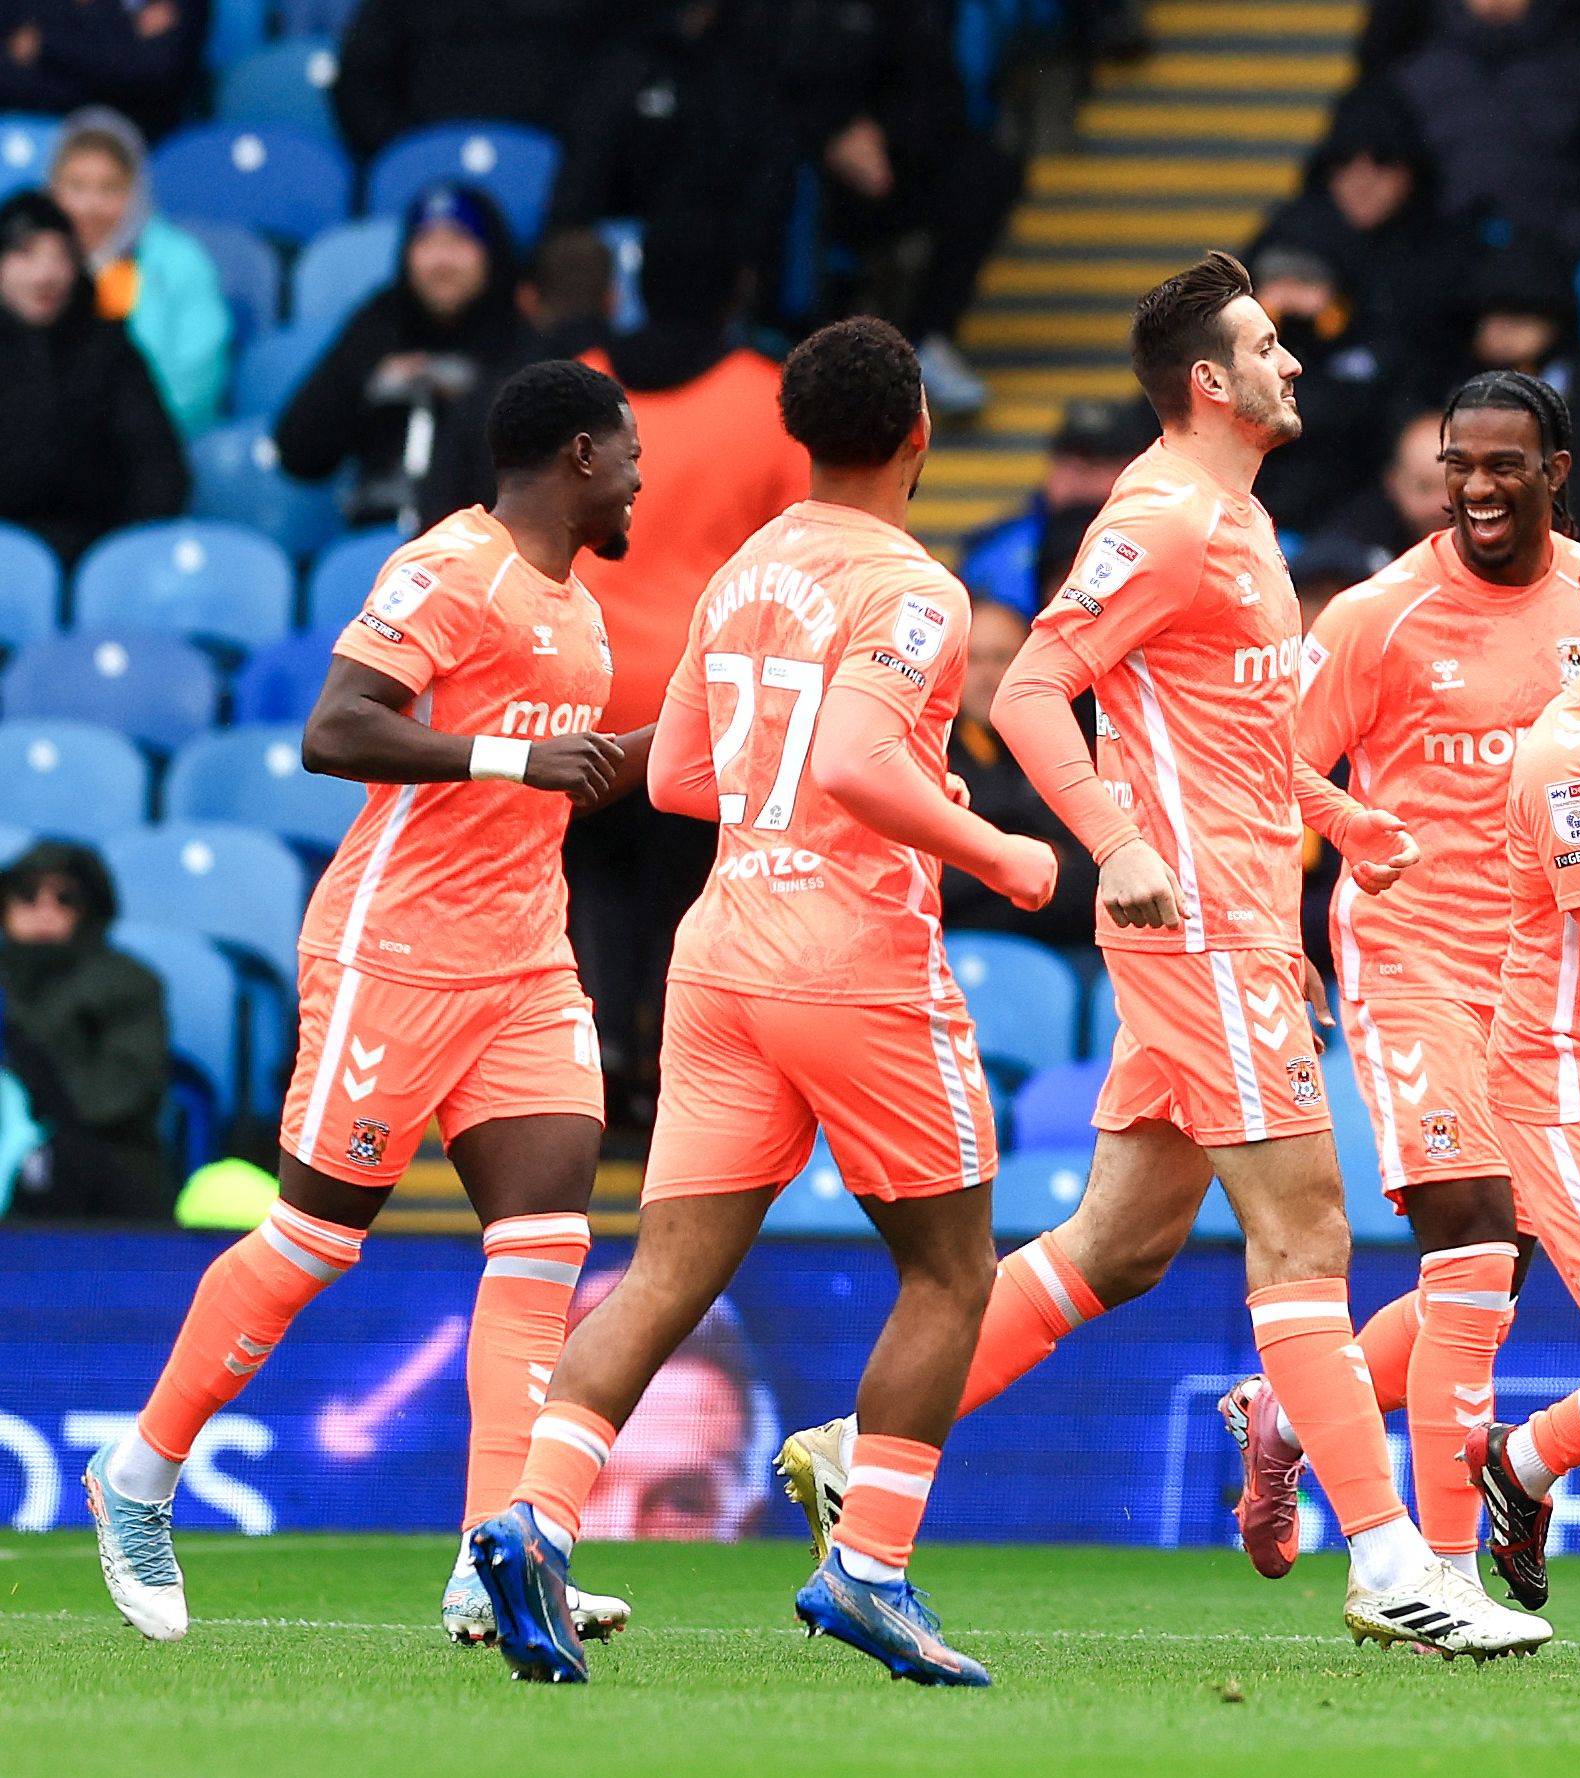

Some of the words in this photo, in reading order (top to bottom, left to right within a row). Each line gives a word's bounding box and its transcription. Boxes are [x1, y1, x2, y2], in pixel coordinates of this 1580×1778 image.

[707, 565, 758, 633] VAN
[760, 562, 837, 653] EWIJK
[1234, 635, 1302, 683] mon
[704, 652, 824, 830] 27
[1550, 789, 1568, 799] sky
[769, 876, 825, 895] USINESS
